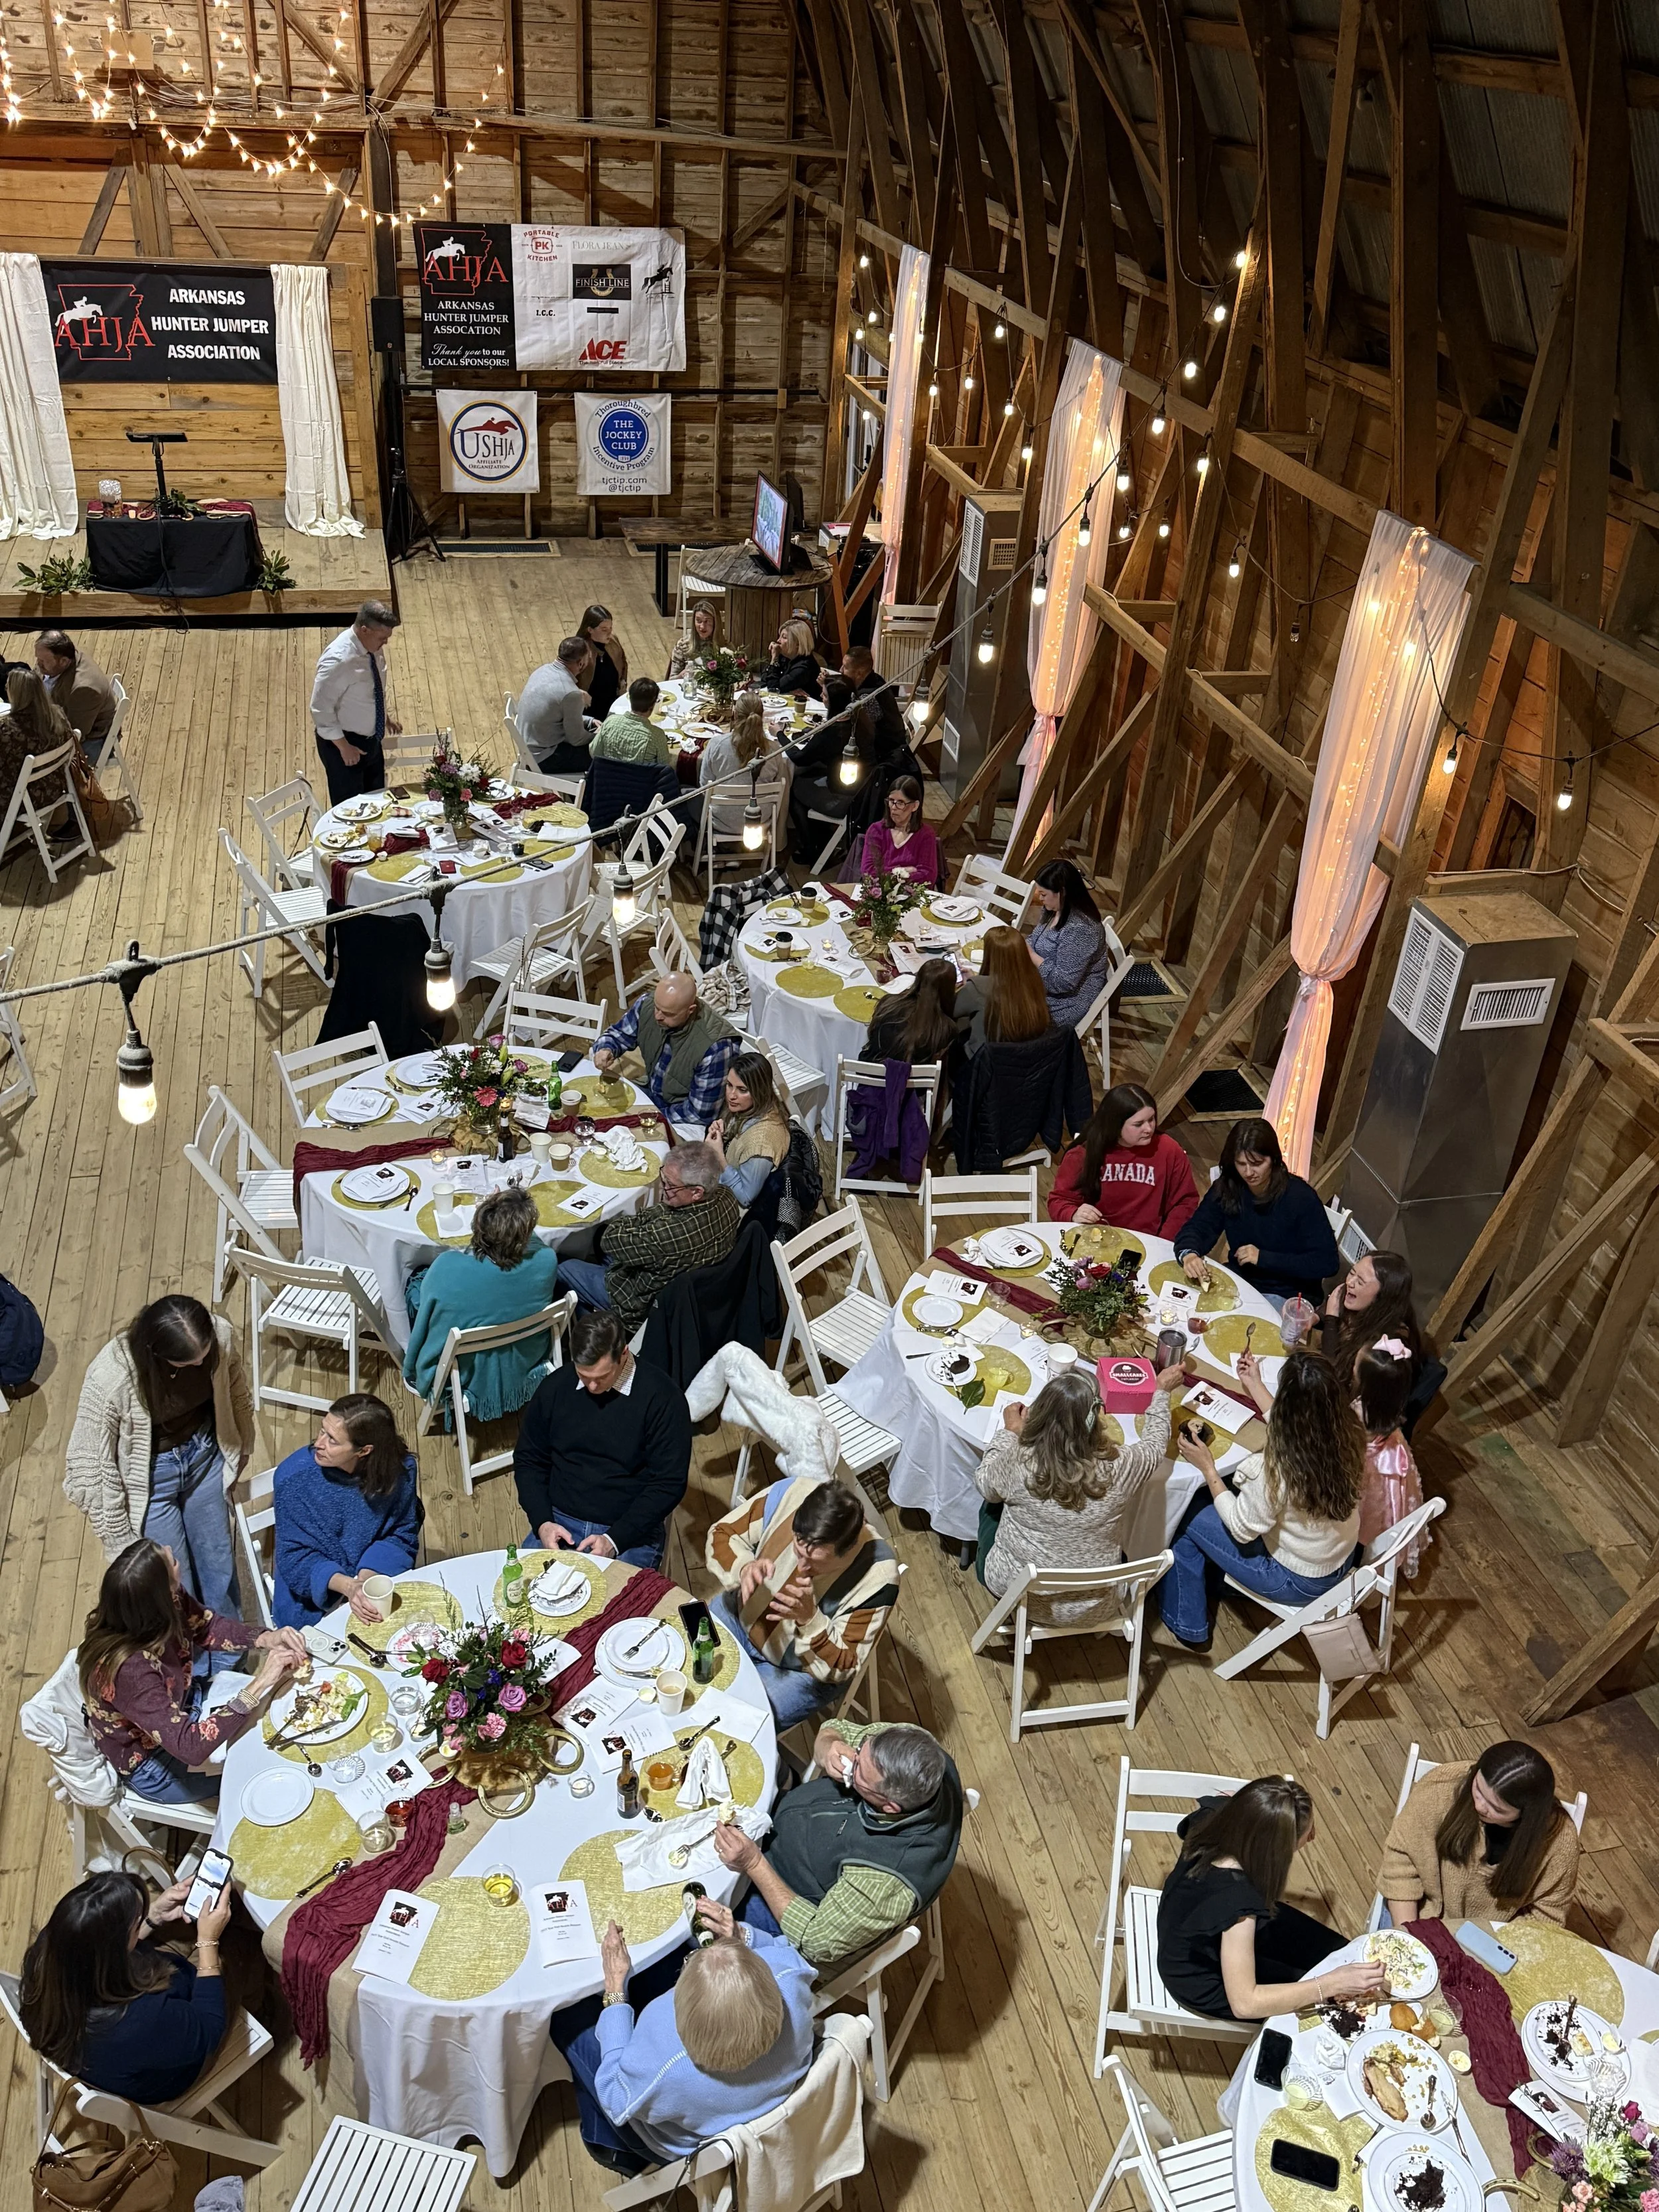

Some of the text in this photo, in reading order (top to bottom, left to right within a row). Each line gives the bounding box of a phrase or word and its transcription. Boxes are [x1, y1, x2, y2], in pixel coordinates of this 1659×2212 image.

[524, 230, 559, 238] PORTABLE
[535, 241, 549, 250] PK
[573, 241, 600, 250] FLORA
[421, 255, 509, 288] AHJA
[169, 288, 246, 305] ARKANSAS
[437, 301, 495, 311] ARKANSAS
[151, 316, 269, 334] HUNTER JUMPER
[423, 313, 509, 324] HUNTER JUMPER
[54, 315, 156, 352] AHJA
[433, 325, 501, 335] ASSOCATION
[167, 344, 261, 360] ASSOCIATION
[431, 343, 463, 356] Thank
[463, 349, 482, 358] you
[579, 337, 627, 360] ACE
[459, 358, 510, 366] SPONSORS!
[595, 400, 651, 419] Thoroughbred
[605, 431, 642, 439] JOCKEY
[457, 428, 515, 461] USHJA
[593, 445, 655, 471] Incentive Program
[602, 476, 647, 484] tjctip.com
[609, 484, 641, 492] @tjctip
[1100, 1163, 1155, 1187] ANADA
